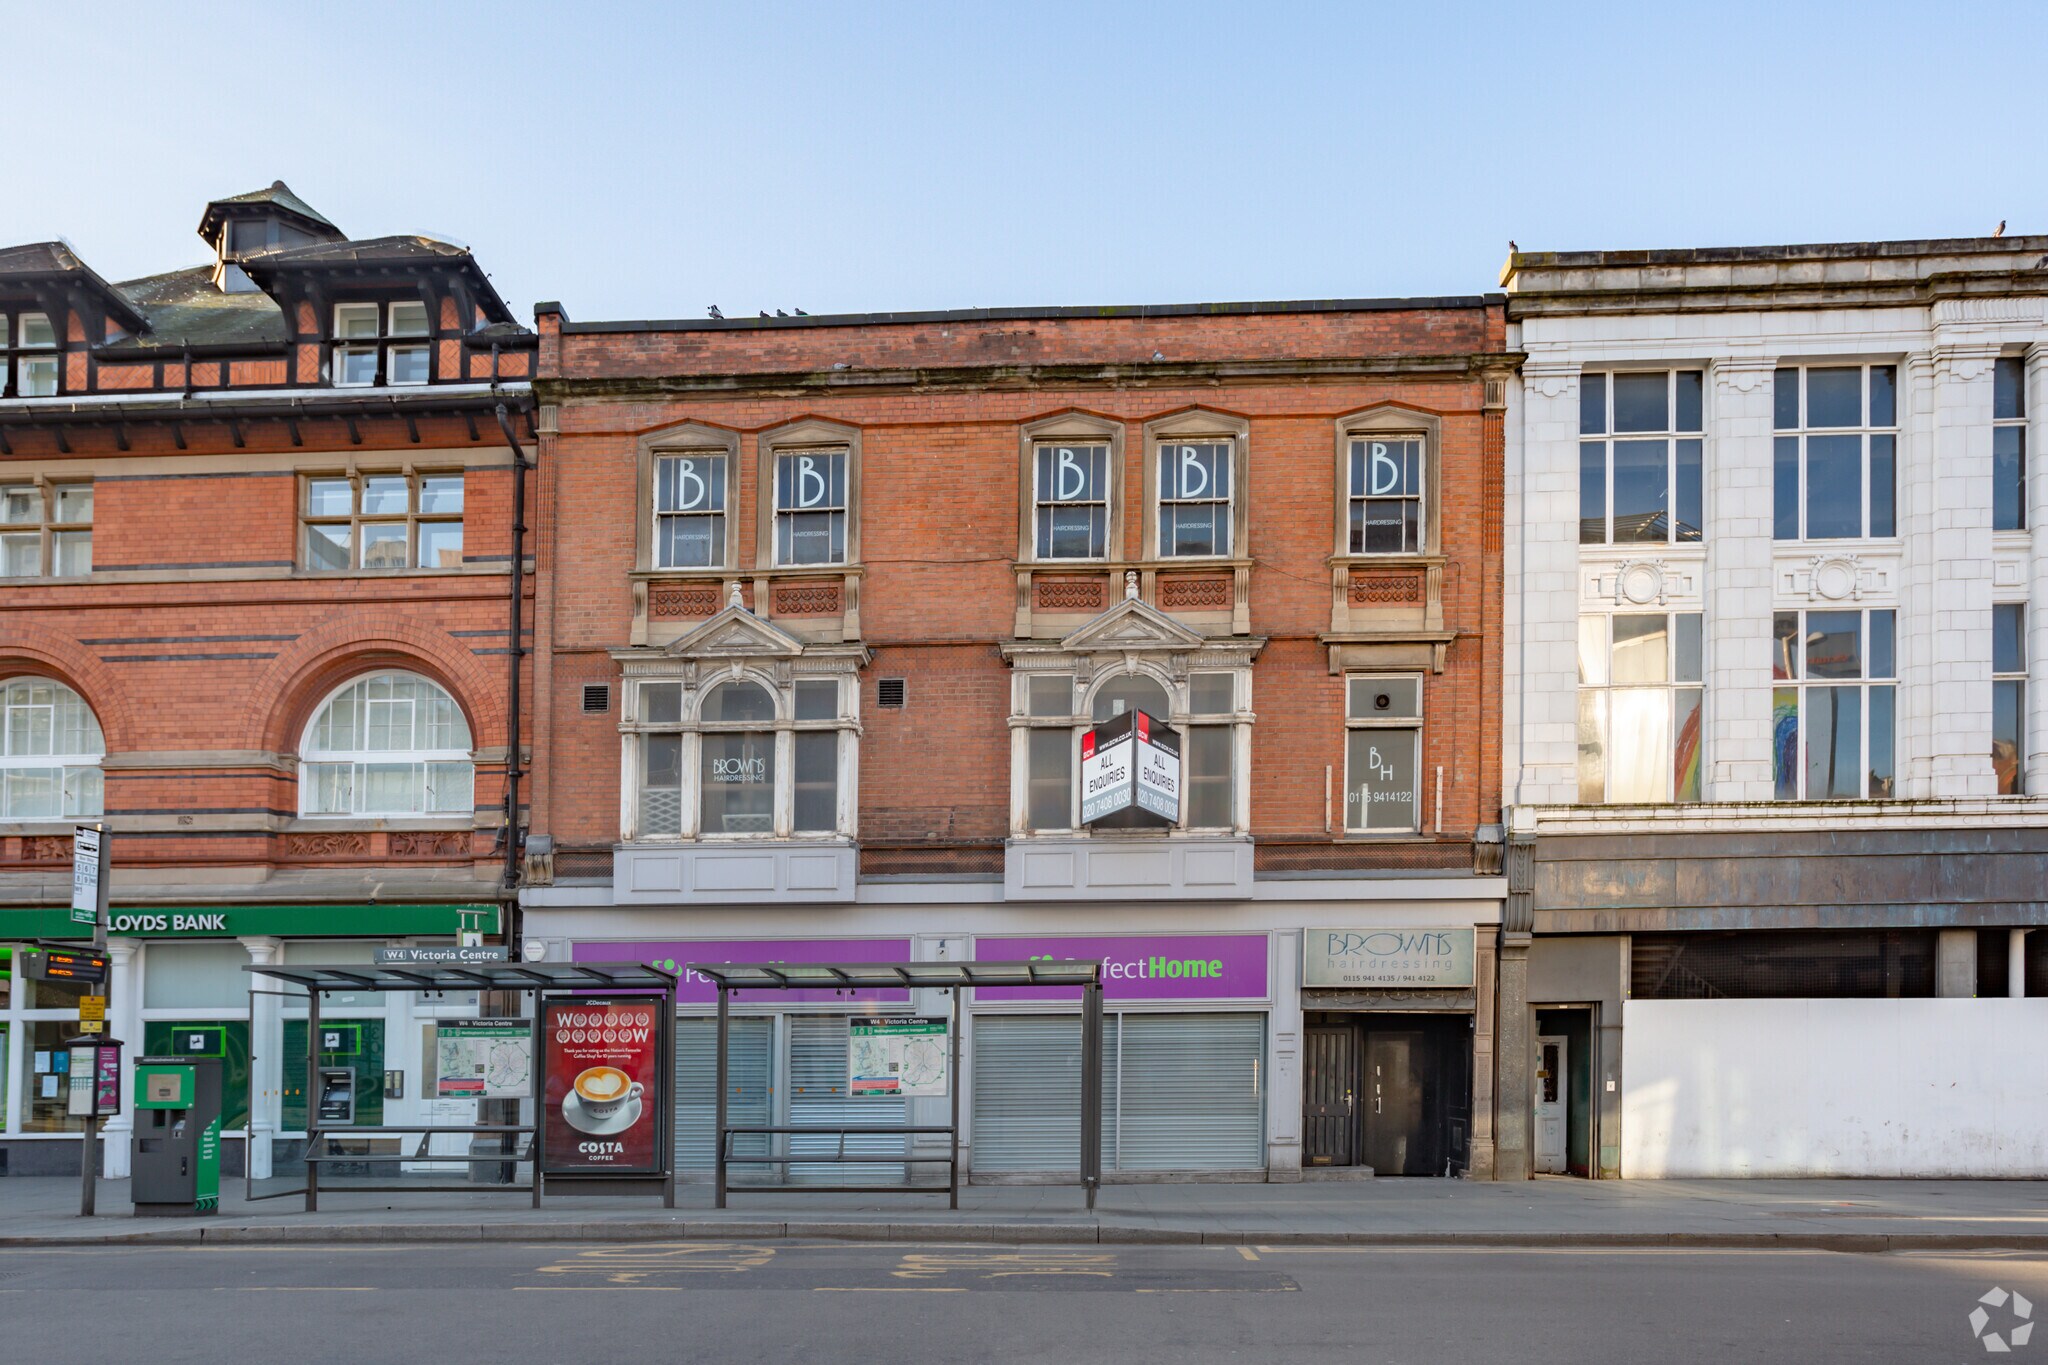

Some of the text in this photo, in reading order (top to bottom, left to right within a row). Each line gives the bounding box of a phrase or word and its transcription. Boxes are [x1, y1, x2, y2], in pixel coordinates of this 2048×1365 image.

[1058, 448, 1085, 500] B
[1182, 447, 1208, 498] B
[1372, 443, 1398, 494] B
[679, 460, 705, 510] B
[800, 456, 825, 508] B
[713, 758, 764, 774] BROWNS
[1100, 754, 1114, 770] ALL
[1154, 754, 1166, 770] ALL
[1089, 766, 1125, 793] ENQUIRIES
[1144, 767, 1174, 792] ENQUIRIES
[1083, 788, 1131, 818] 020 7408 0030
[1138, 788, 1148, 804] 020
[1149, 794, 1163, 811] 7408
[1374, 791, 1412, 802] 9414122
[107, 914, 167, 931] LOYDS
[172, 914, 226, 931] BANK
[386, 950, 498, 960] W4 Victoria Centre
[1328, 933, 1452, 956] BROWNS
[1102, 956, 1222, 978] fectHome
[1328, 958, 1452, 970] hairdressing
[578, 1142, 624, 1154] COSTA
